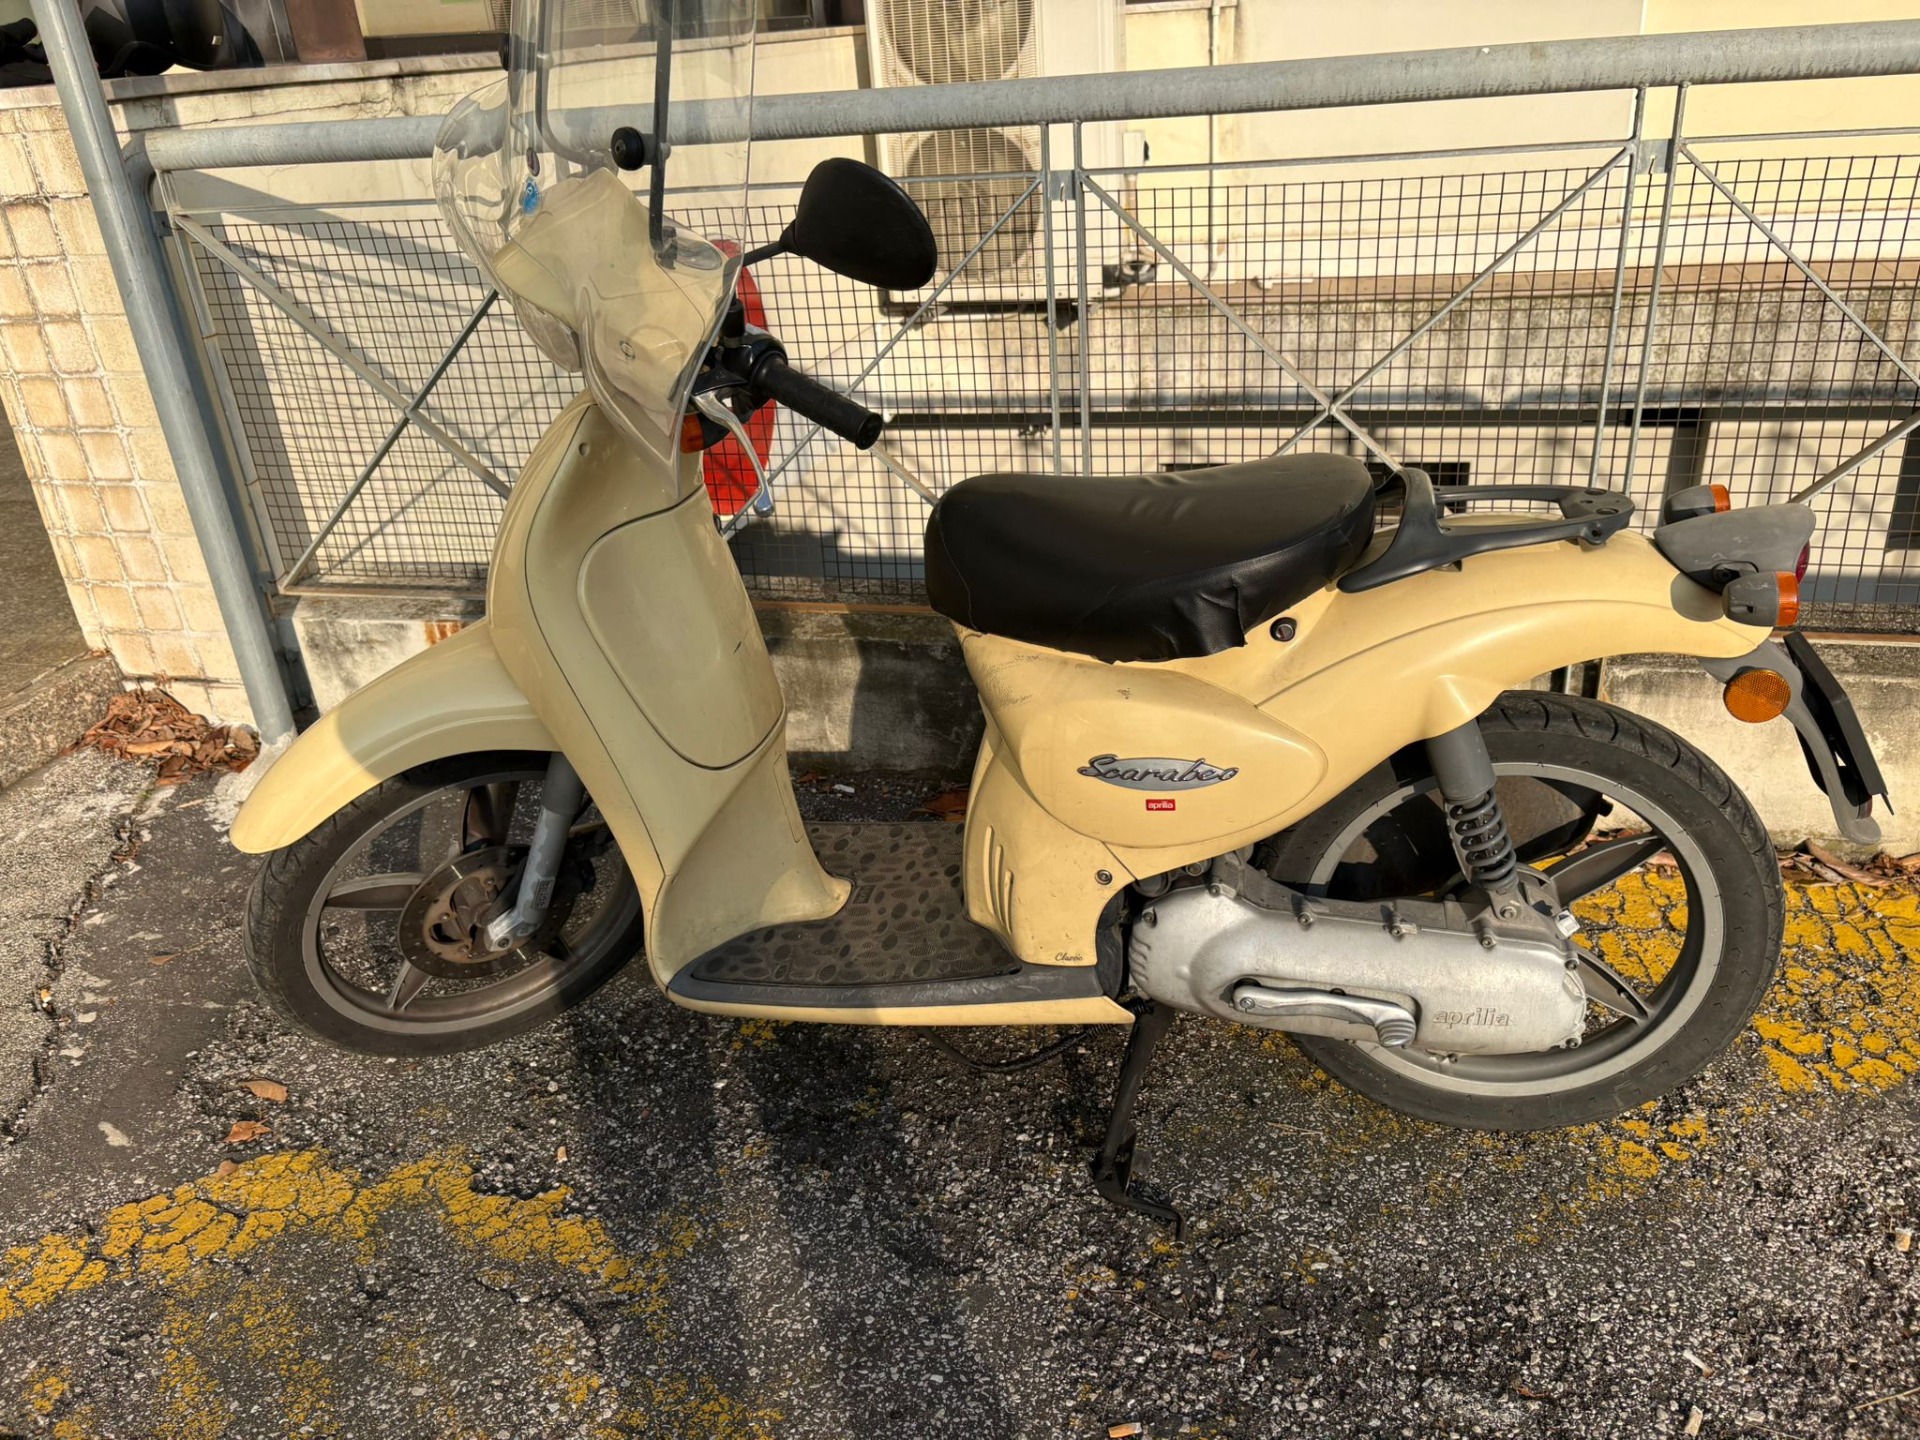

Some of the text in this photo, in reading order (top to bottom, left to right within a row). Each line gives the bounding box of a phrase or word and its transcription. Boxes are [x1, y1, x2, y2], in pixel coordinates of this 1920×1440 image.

[1077, 754, 1239, 782] Scarabeo
[1147, 801, 1174, 810] aprilia
[1432, 1007, 1511, 1029] aprilia
